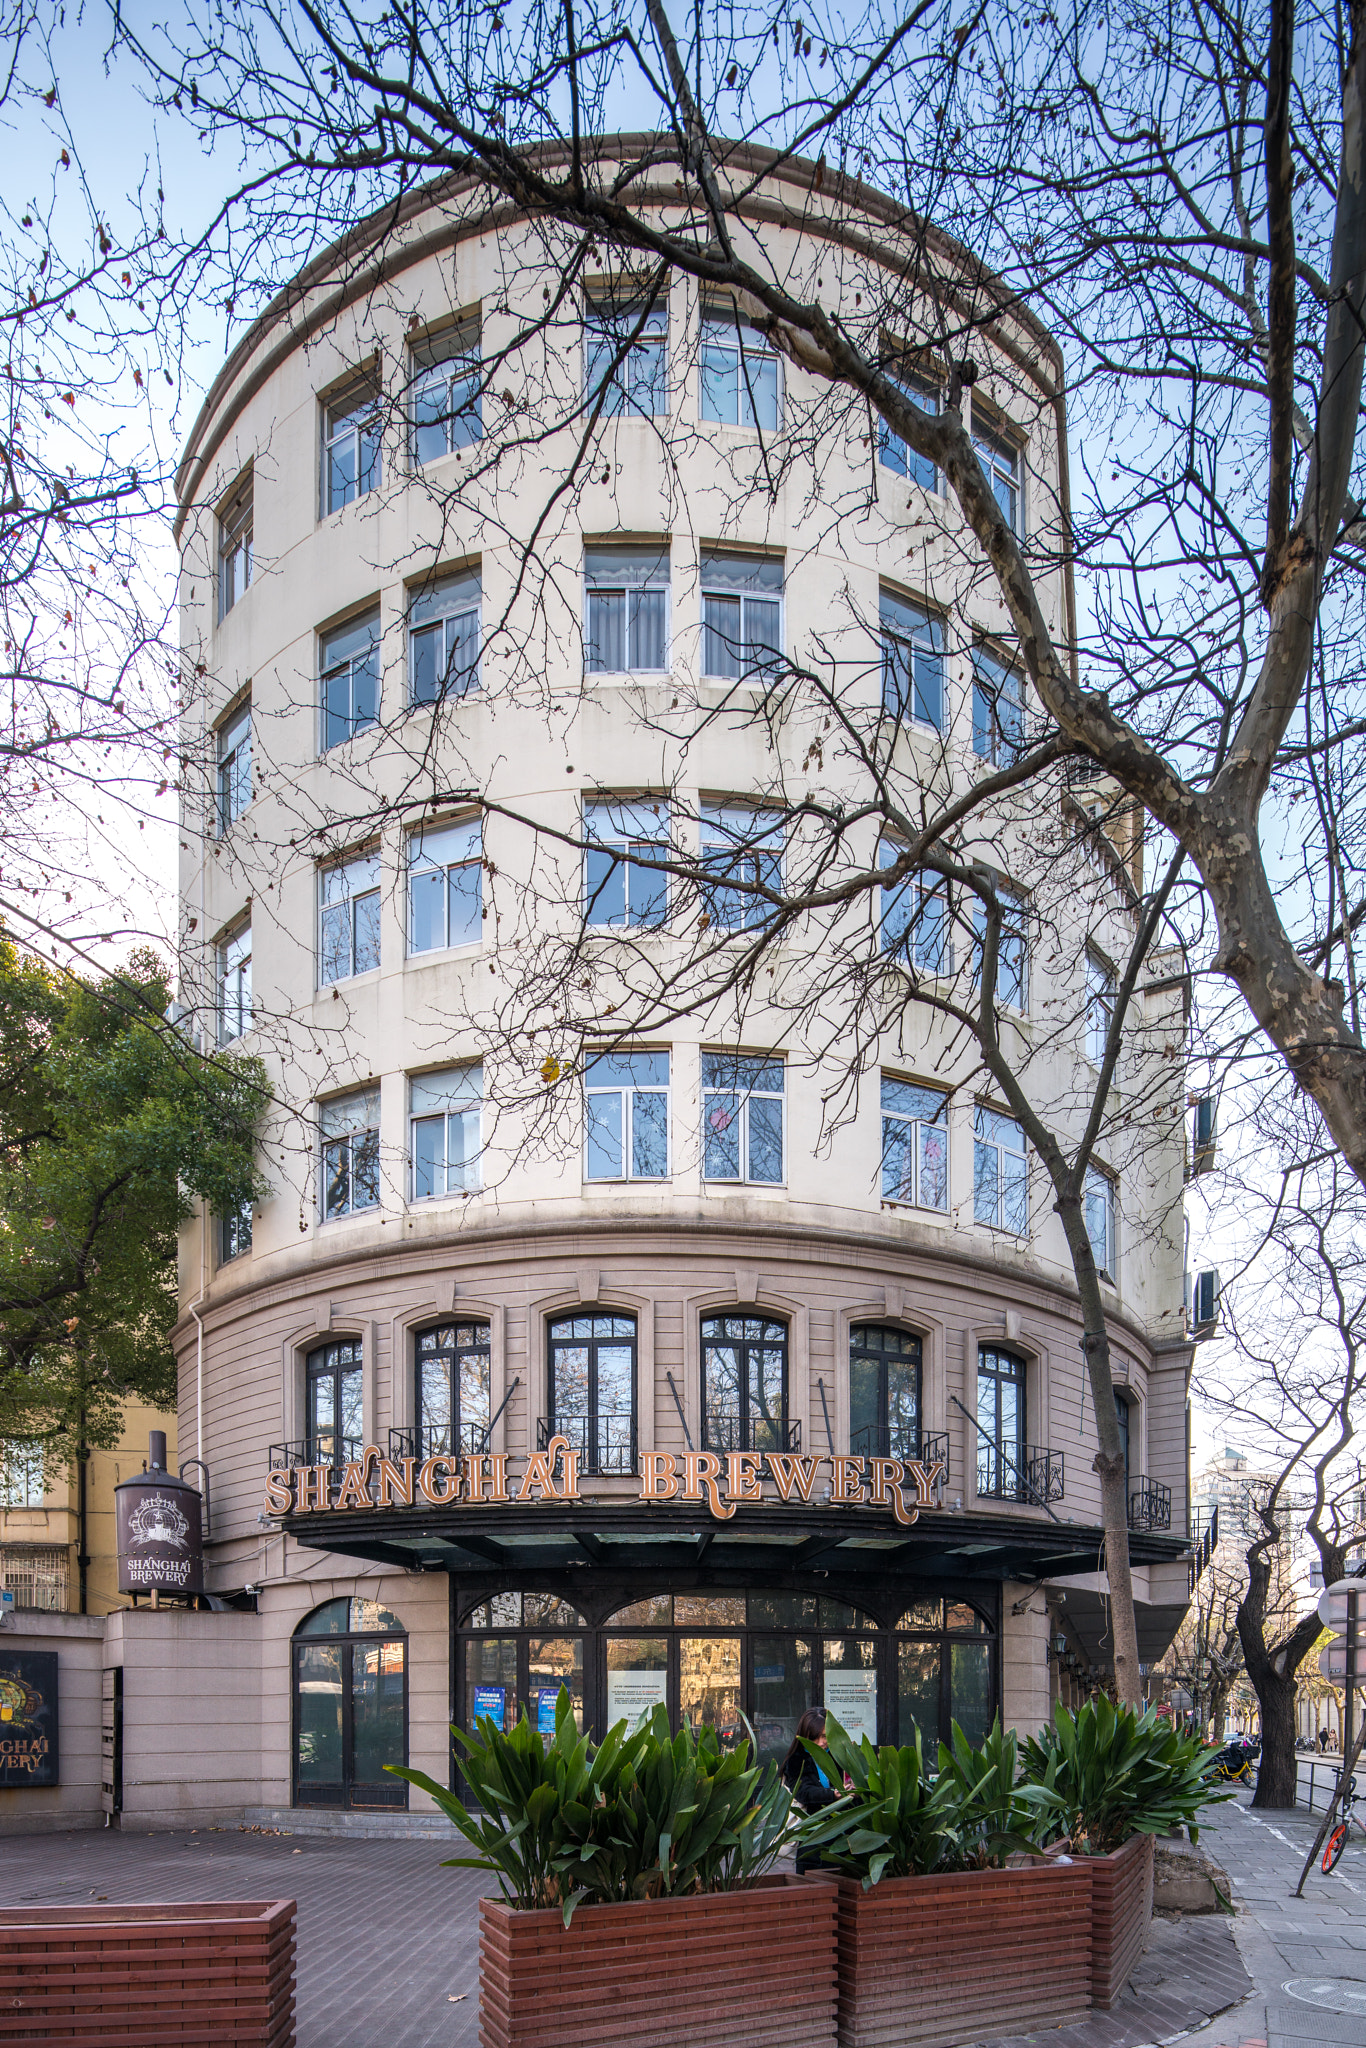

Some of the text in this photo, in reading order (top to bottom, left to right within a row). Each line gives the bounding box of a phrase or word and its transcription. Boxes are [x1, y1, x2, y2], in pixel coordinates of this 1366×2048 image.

[263, 1435, 945, 1526] SHANGHAI BREWERY
[127, 1556, 191, 1573] SHANGHAI
[130, 1570, 188, 1586] BREWERY
